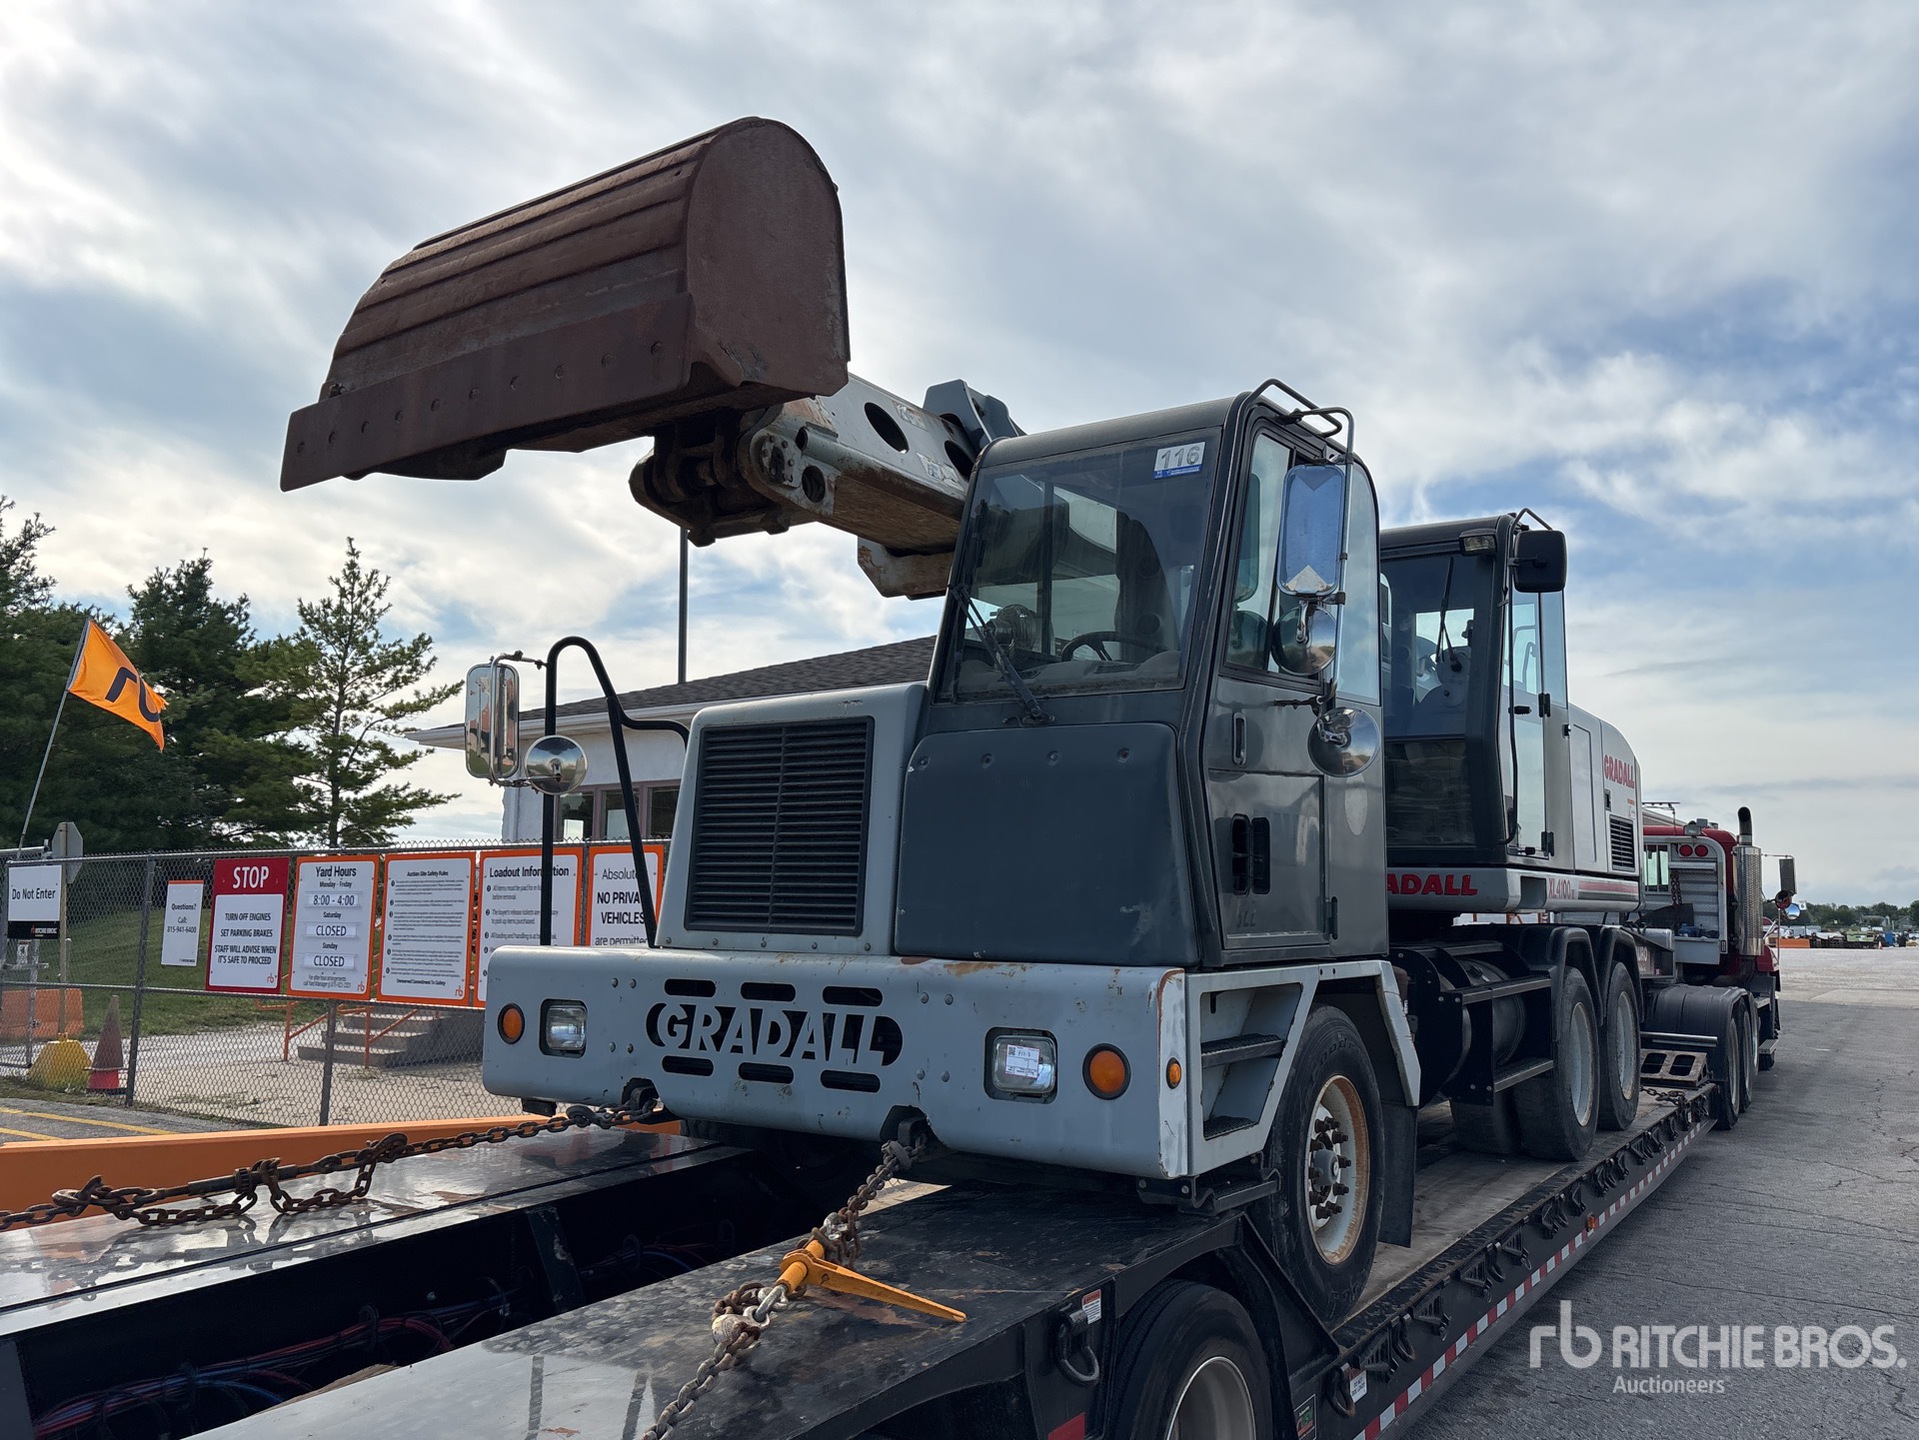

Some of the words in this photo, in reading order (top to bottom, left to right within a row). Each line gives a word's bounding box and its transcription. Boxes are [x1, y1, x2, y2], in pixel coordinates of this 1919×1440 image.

[1161, 446, 1200, 469] 116
[1604, 754, 1635, 789] GRADALL
[232, 866, 269, 889] STOP
[315, 866, 332, 878] Yard
[334, 865, 357, 877] Hours
[489, 866, 520, 878] Loadout
[522, 865, 569, 877] Infortion
[319, 881, 336, 889] Monday
[339, 880, 352, 888] Friday
[1387, 873, 1478, 896] ADALL
[12, 888, 20, 900] Do
[22, 888, 34, 900] Not
[35, 887, 56, 899] Enter
[597, 891, 611, 904] NO
[612, 891, 641, 904] PRIVA
[313, 894, 331, 906] 8:00
[337, 894, 355, 906] 4:00
[171, 903, 197, 911] Questions?
[225, 913, 239, 921] TURN
[239, 913, 249, 921] OFF
[249, 913, 271, 921] ENGINES
[323, 911, 341, 920] Saturday
[601, 912, 645, 924] VEHICLES
[220, 928, 229, 937] SET
[230, 929, 252, 938] PARKING
[253, 929, 273, 938] BRAKES
[315, 925, 347, 937] CLOSED
[322, 942, 338, 950] Sunday
[595, 936, 609, 945] are
[214, 945, 229, 953] STAFF
[229, 945, 241, 953] WILL
[242, 945, 260, 954] ADVISE
[261, 946, 277, 954] WHEN
[217, 955, 228, 964] IT'S
[228, 956, 239, 964] SAFE
[240, 956, 247, 964] TO
[248, 956, 272, 965] PROCEED
[313, 955, 345, 967] CLOSED
[266, 972, 274, 983] rb
[357, 981, 365, 991] rb
[455, 985, 463, 997] rb
[655, 1002, 888, 1066] GRADALL
